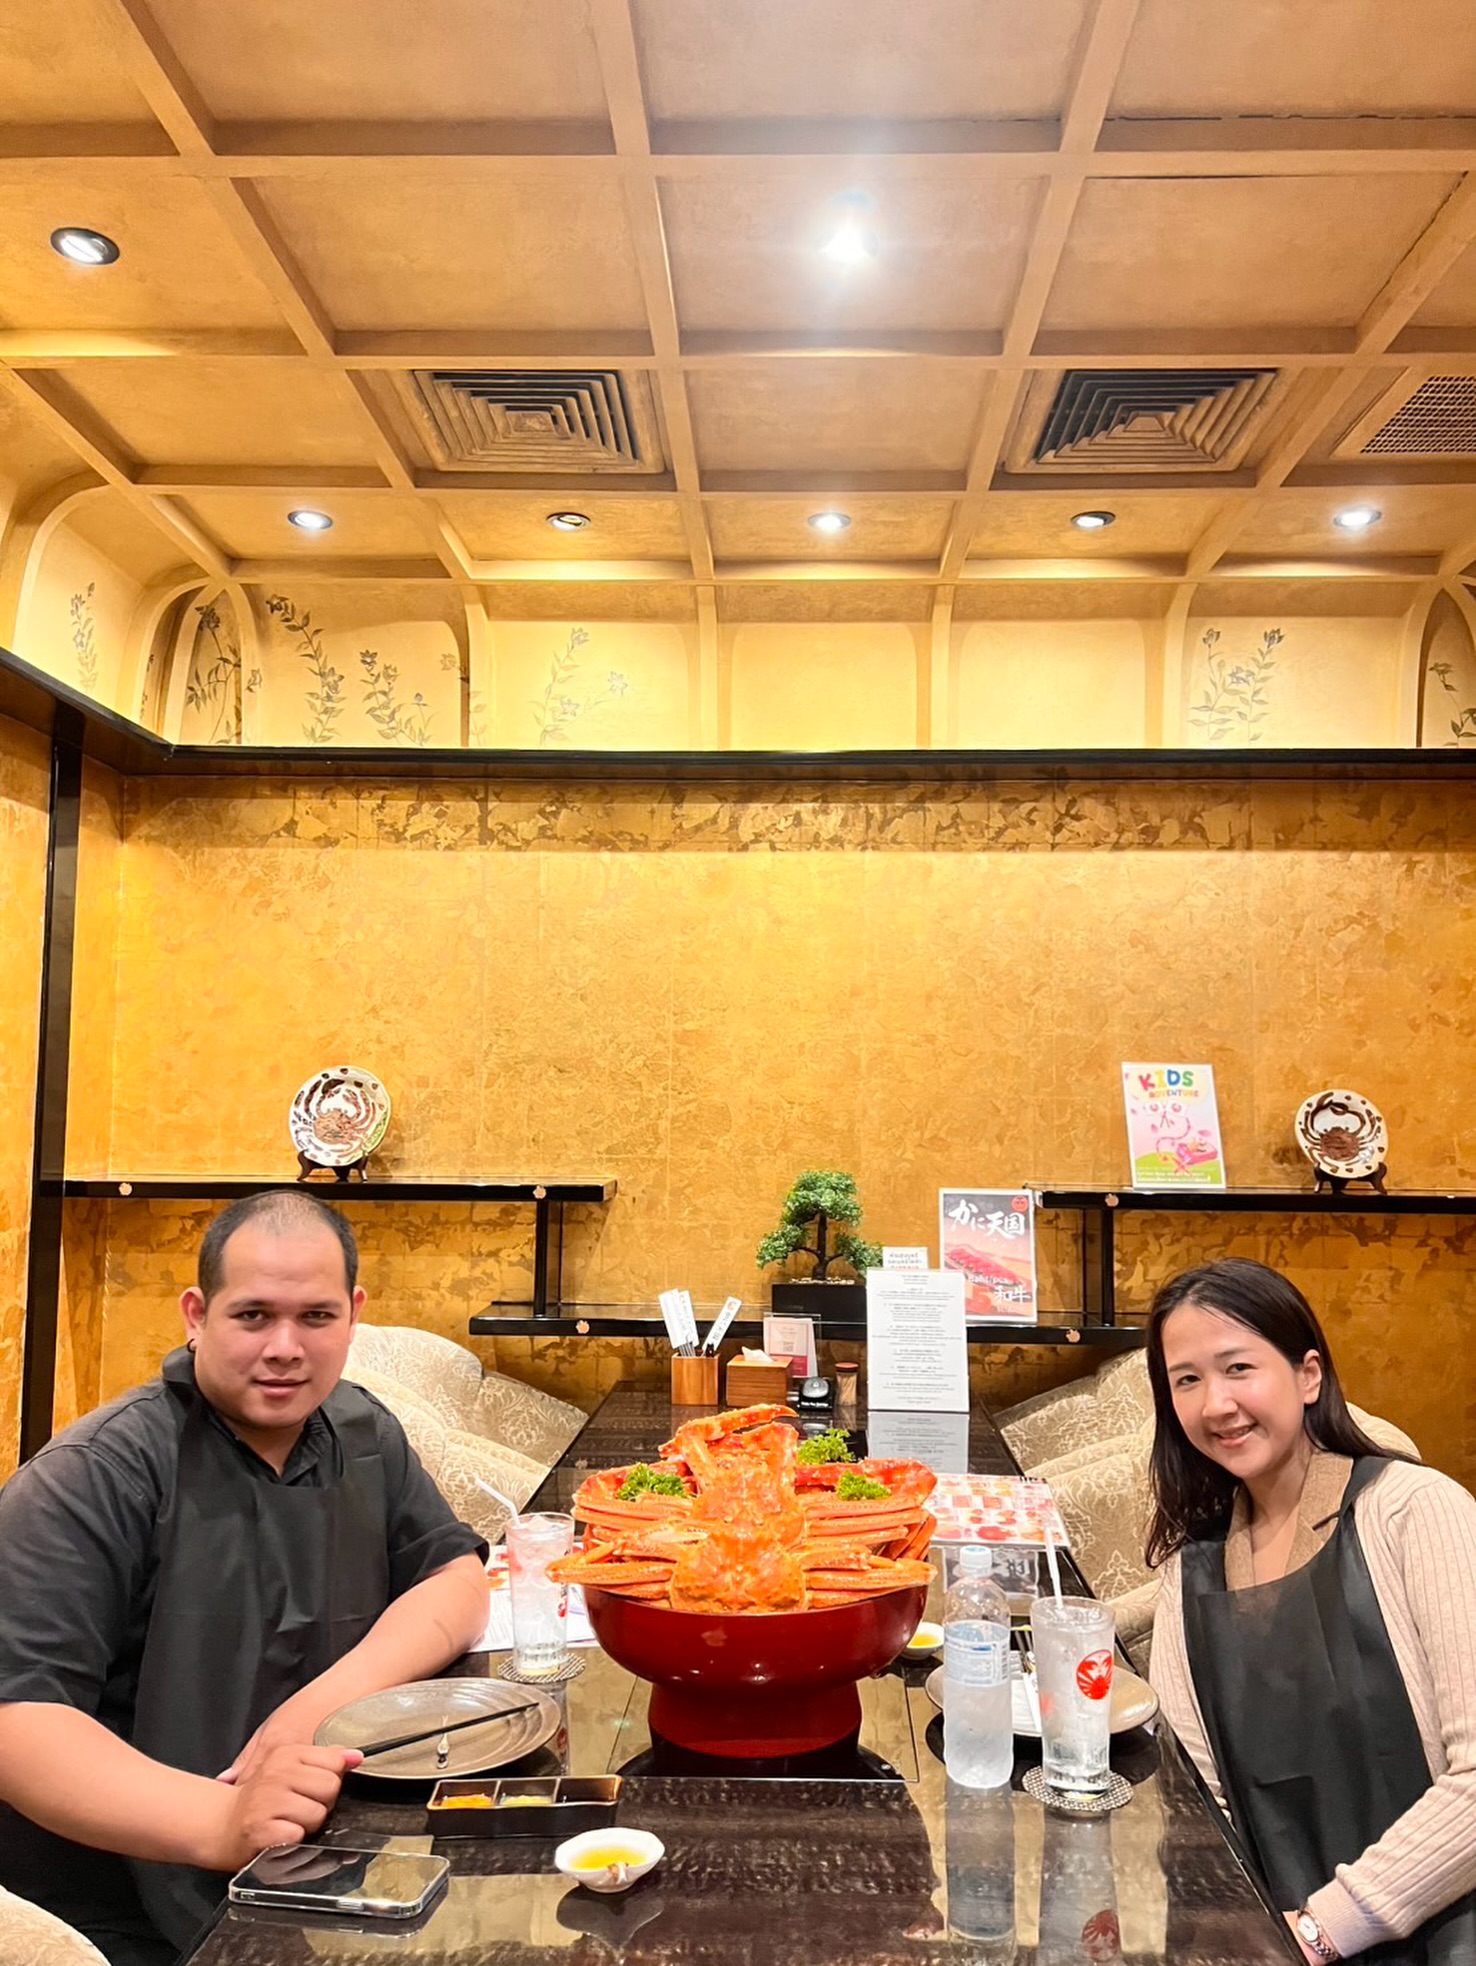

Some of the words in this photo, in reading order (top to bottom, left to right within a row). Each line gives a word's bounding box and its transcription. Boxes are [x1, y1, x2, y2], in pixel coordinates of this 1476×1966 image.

[1138, 1069, 1194, 1091] KIDS
[948, 1199, 1025, 1238] かに天国
